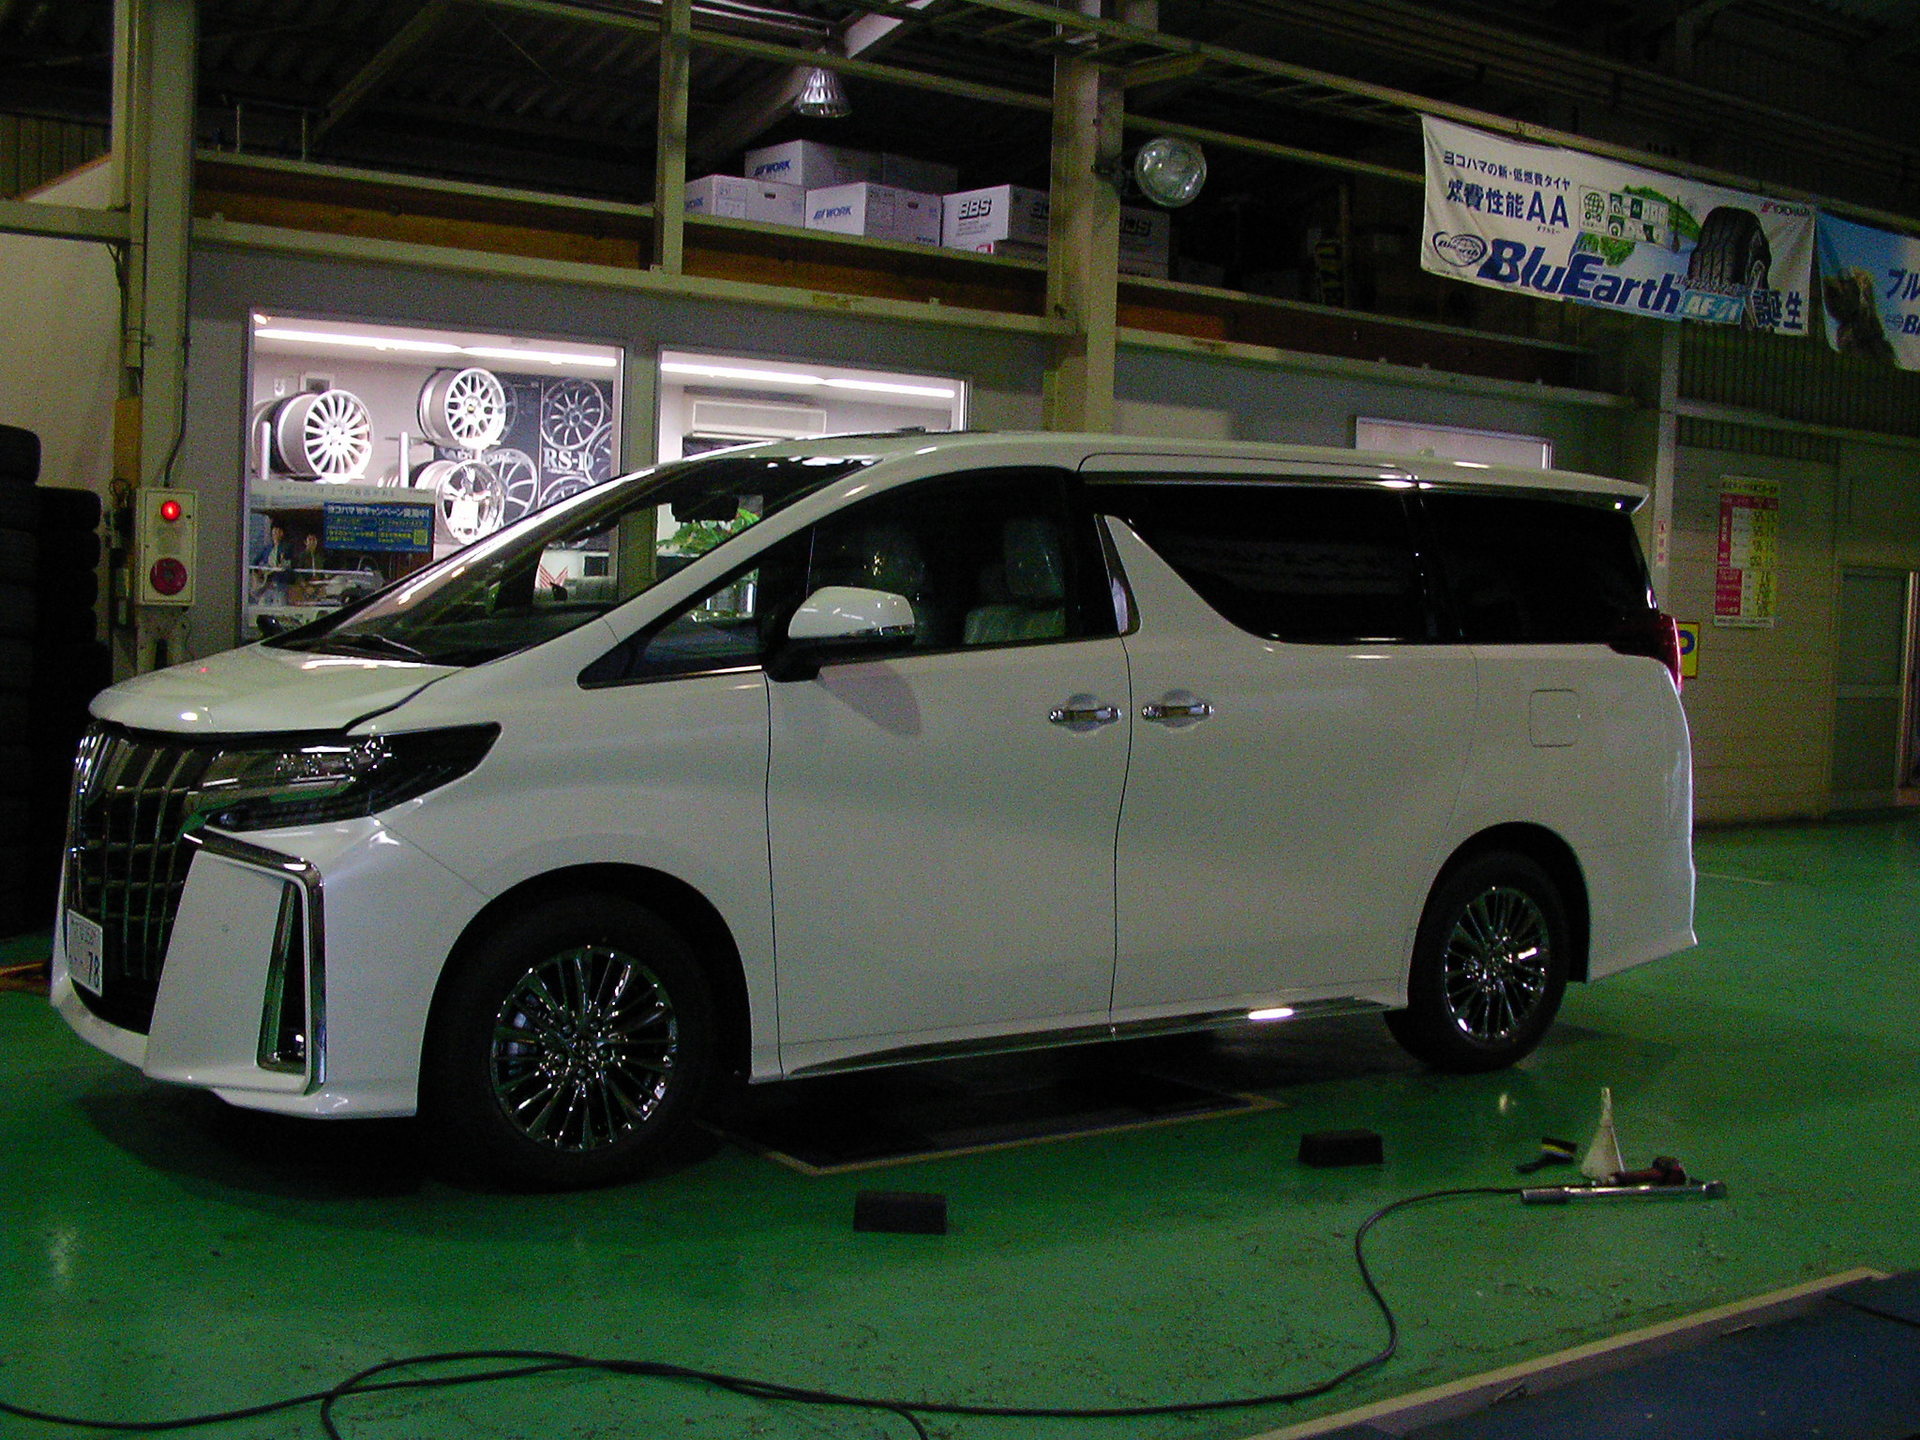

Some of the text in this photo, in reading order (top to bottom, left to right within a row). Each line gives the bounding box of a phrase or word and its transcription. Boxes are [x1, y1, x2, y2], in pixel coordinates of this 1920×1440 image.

[826, 205, 852, 218] WORK
[958, 198, 992, 220] BBS
[1477, 238, 1681, 314] BluEarth
